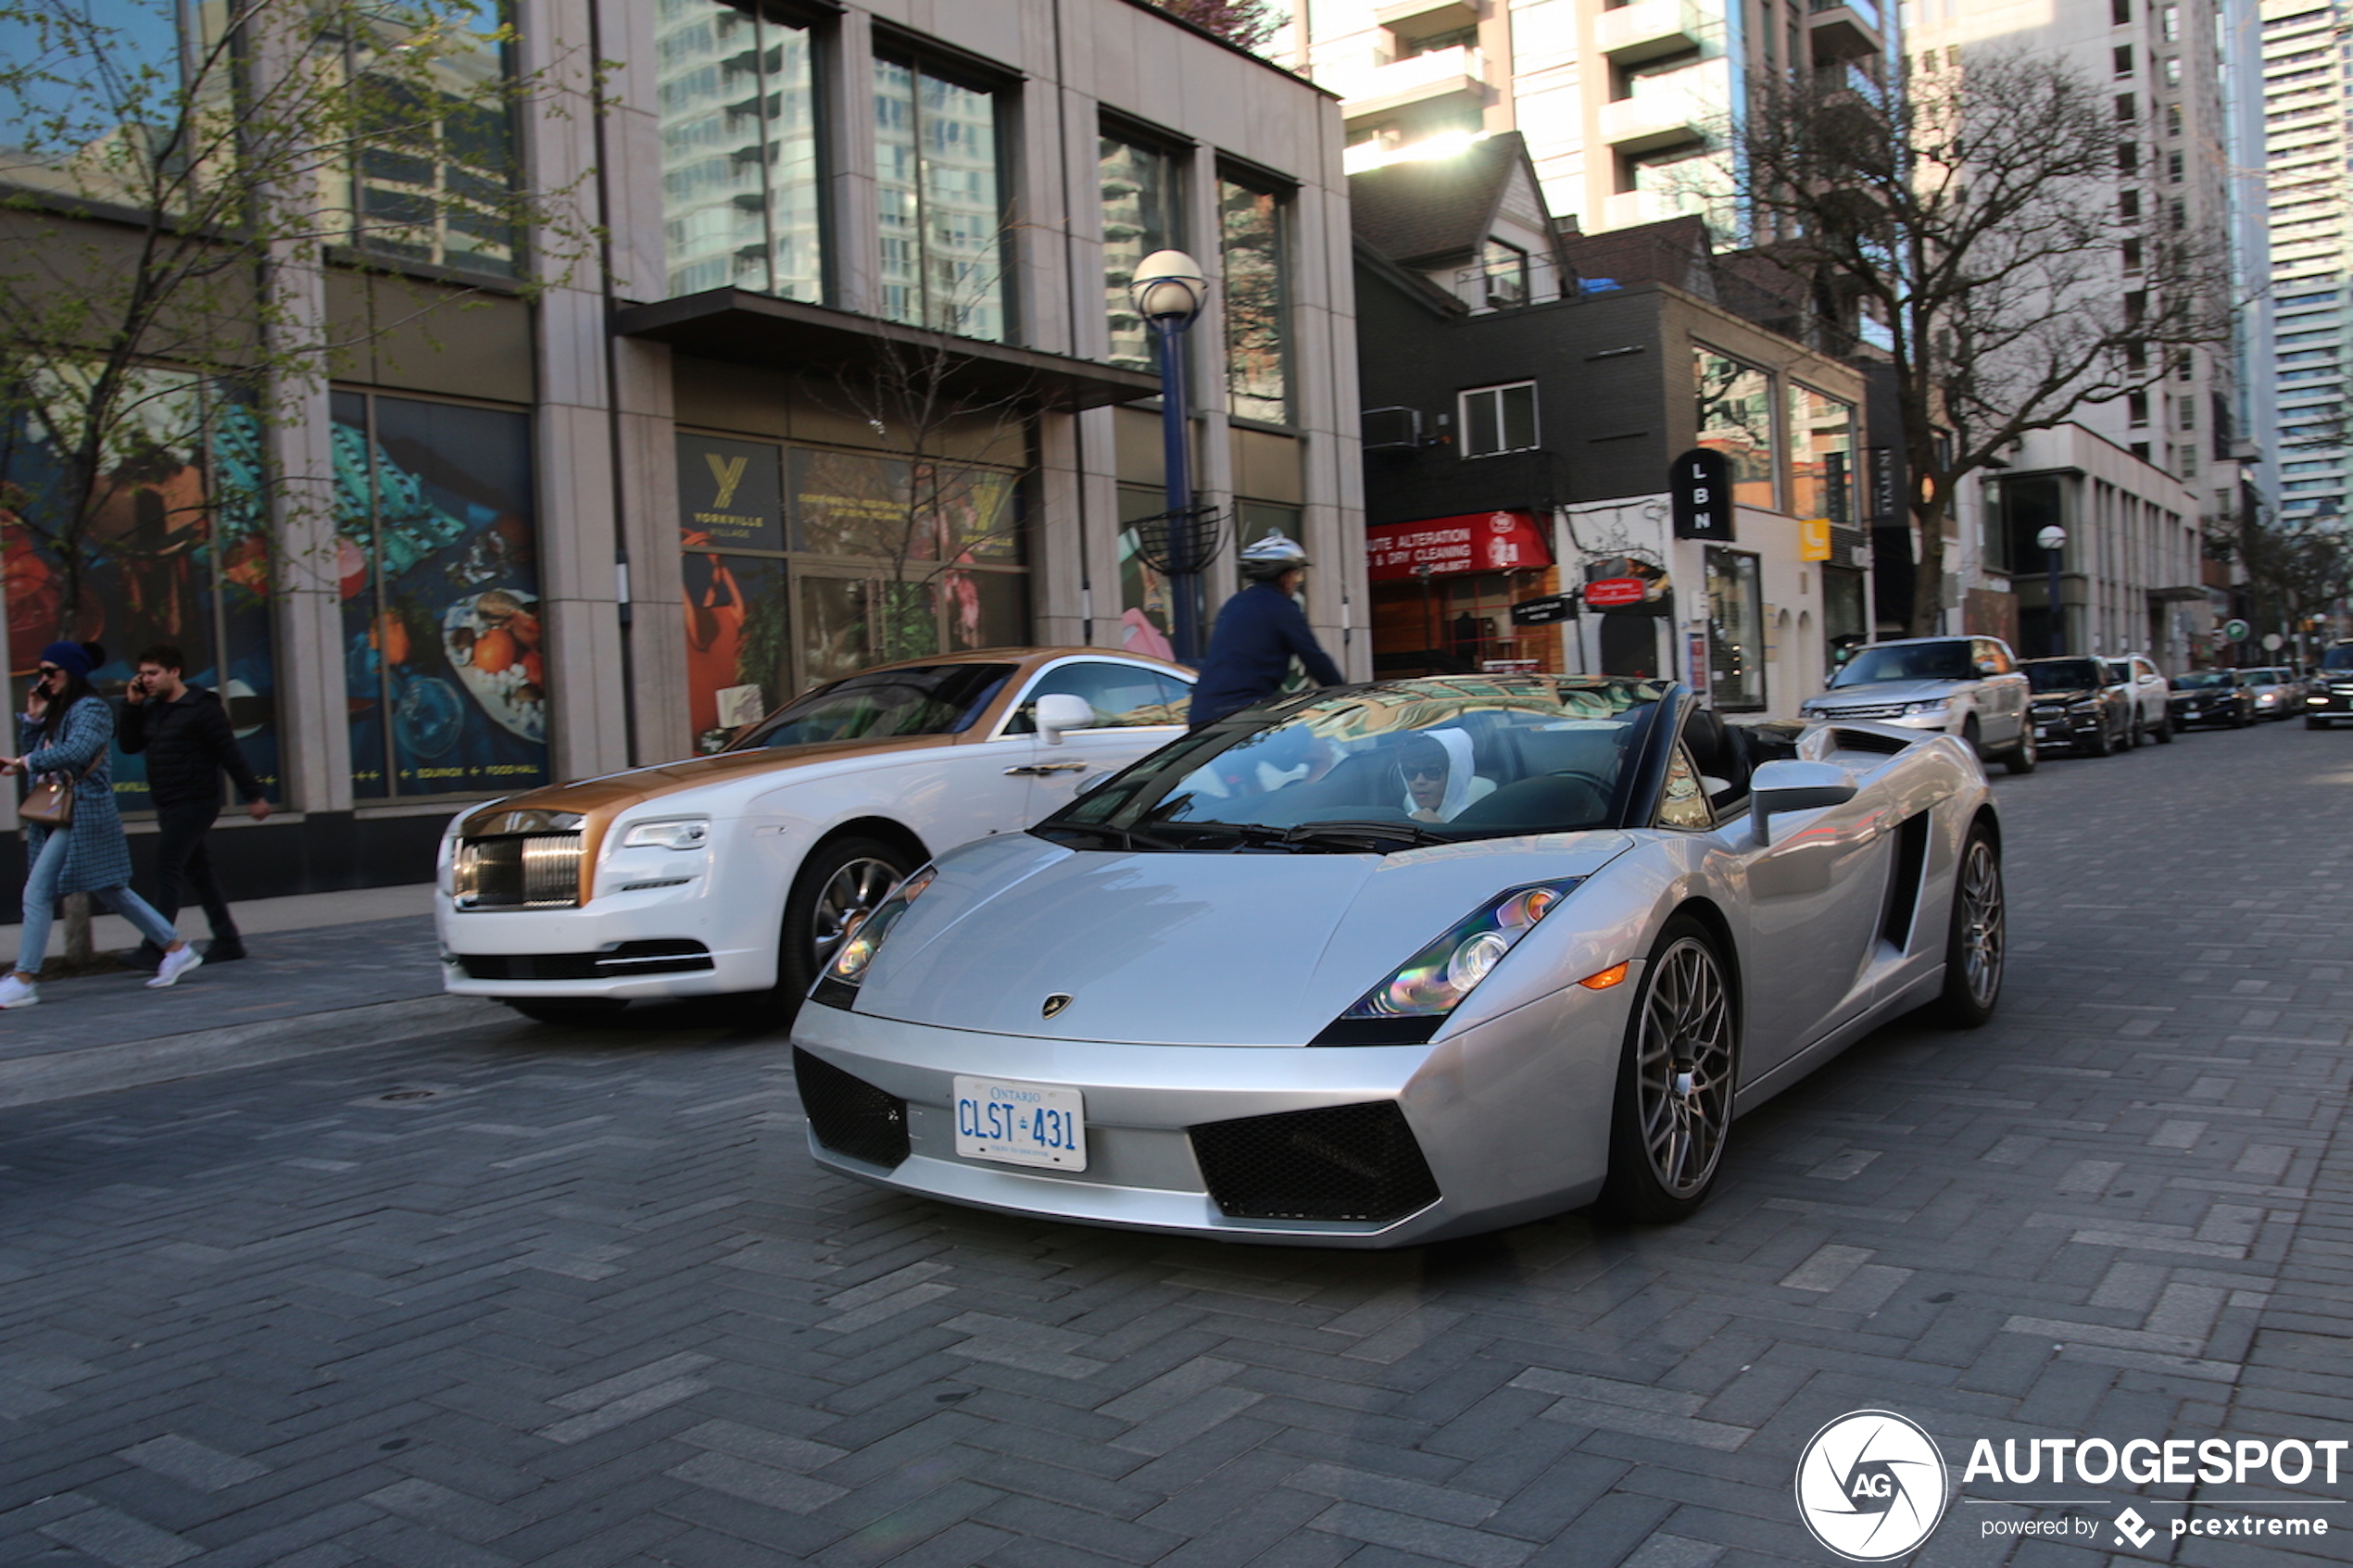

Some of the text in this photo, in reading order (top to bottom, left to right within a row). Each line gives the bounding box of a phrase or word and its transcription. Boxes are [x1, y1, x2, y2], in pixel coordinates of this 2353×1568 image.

[1692, 463, 1711, 529] LBN
[693, 512, 763, 528] YORKVILLE
[1396, 528, 1471, 548] ALTERATION
[1388, 551, 1410, 564] DRY
[1414, 545, 1471, 561] CLEANING
[990, 1086, 1040, 1103] ONTARIO
[959, 1098, 1076, 1150] CLST 431
